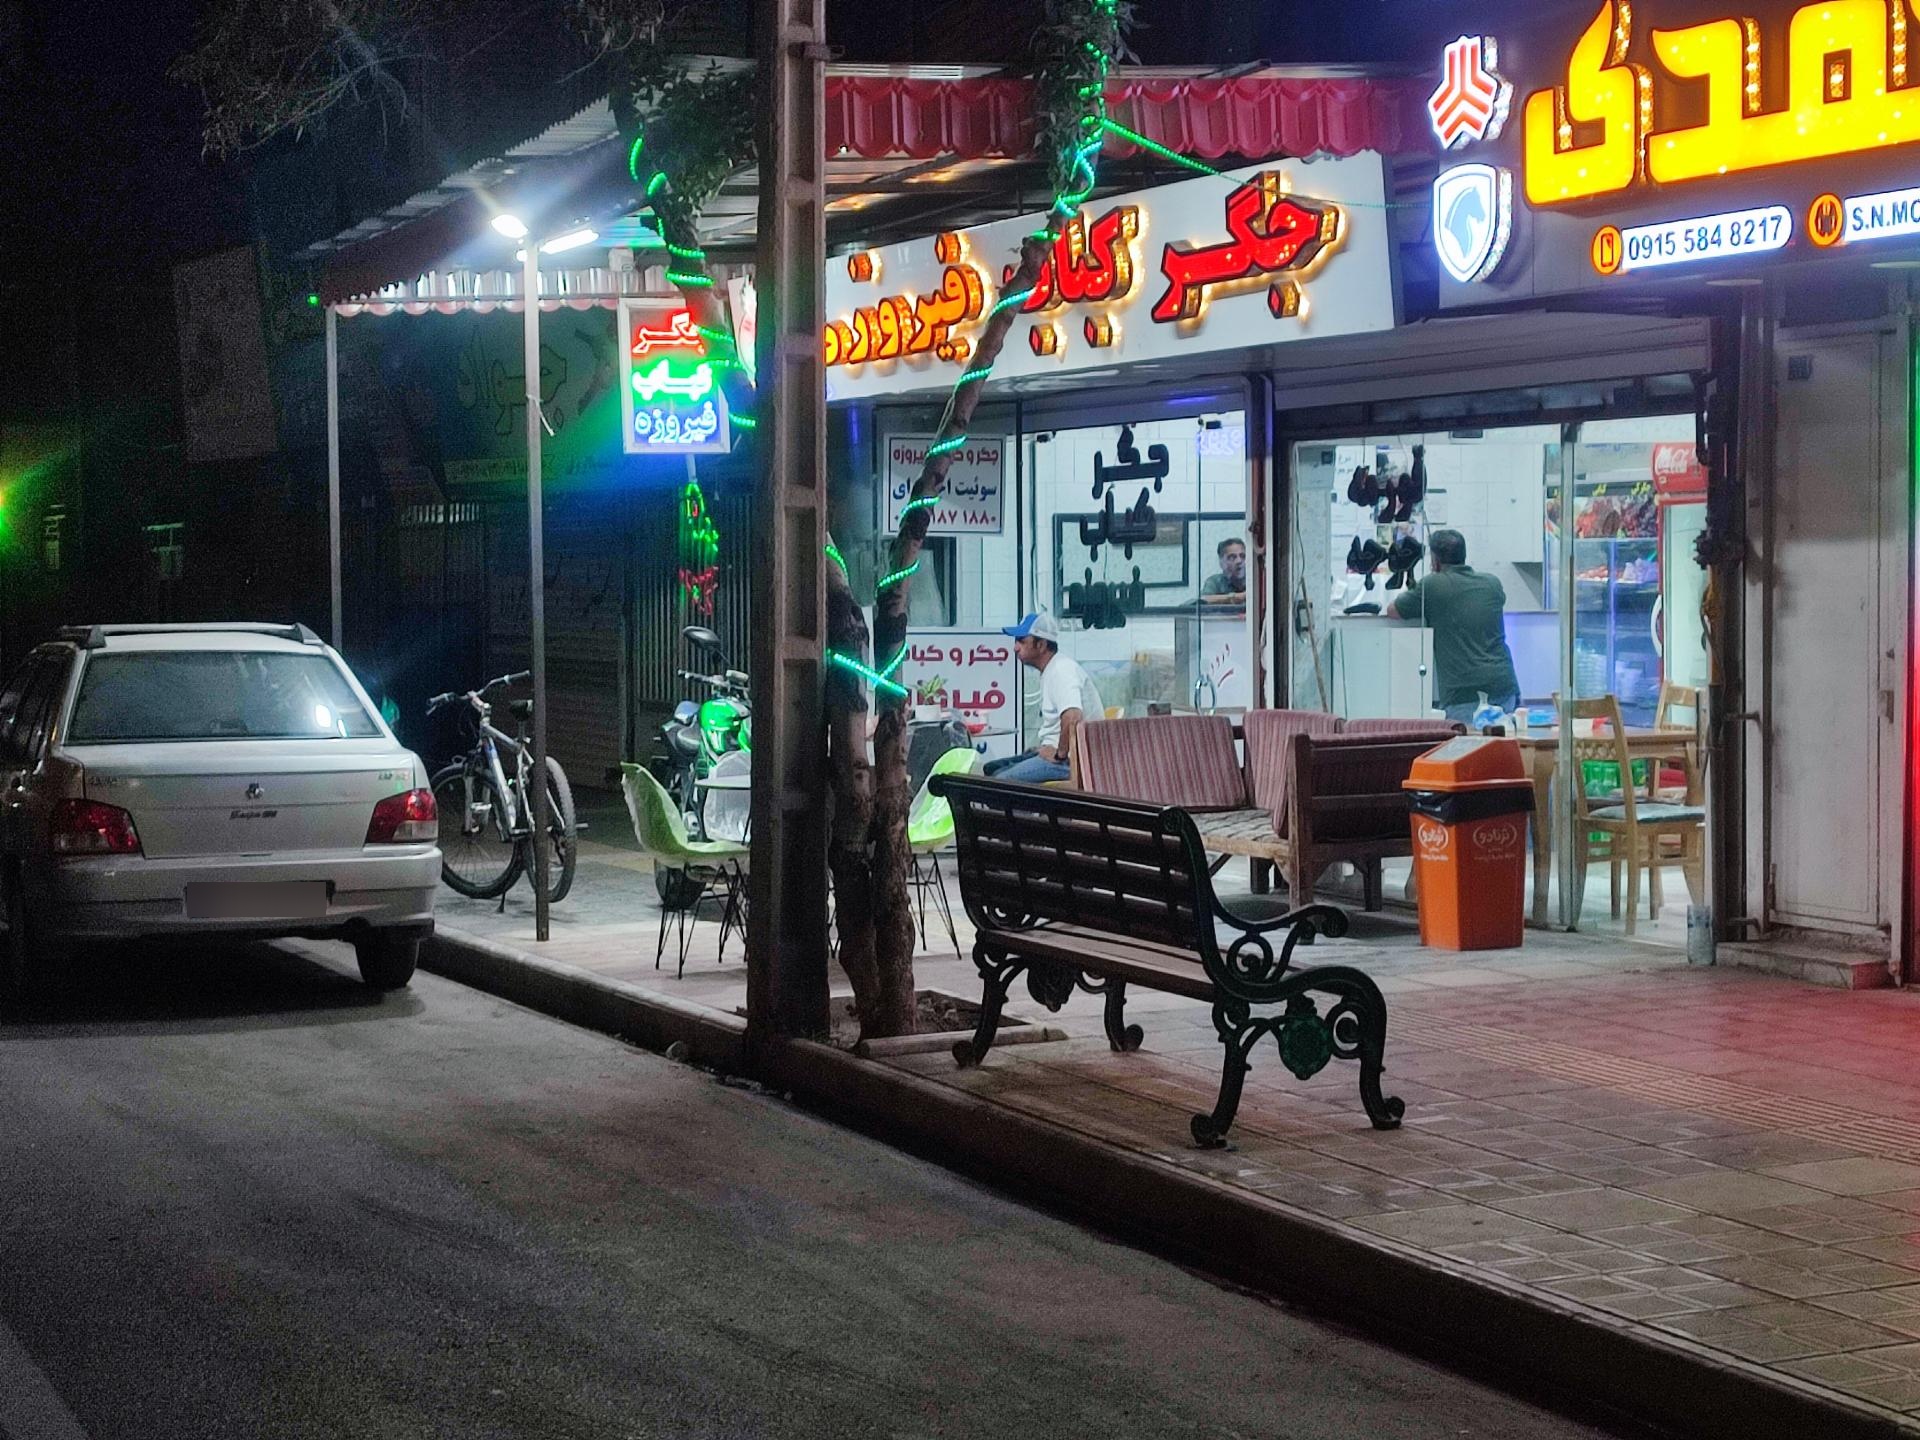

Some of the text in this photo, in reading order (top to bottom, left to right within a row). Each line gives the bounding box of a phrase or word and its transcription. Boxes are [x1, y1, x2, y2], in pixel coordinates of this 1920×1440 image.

[1151, 170, 1340, 323] جگر
[1628, 213, 1783, 261] 0915 584 8217
[634, 400, 718, 444] فیروزه
[962, 509, 997, 525] ۱۸۸۰
[949, 647, 963, 667] و
